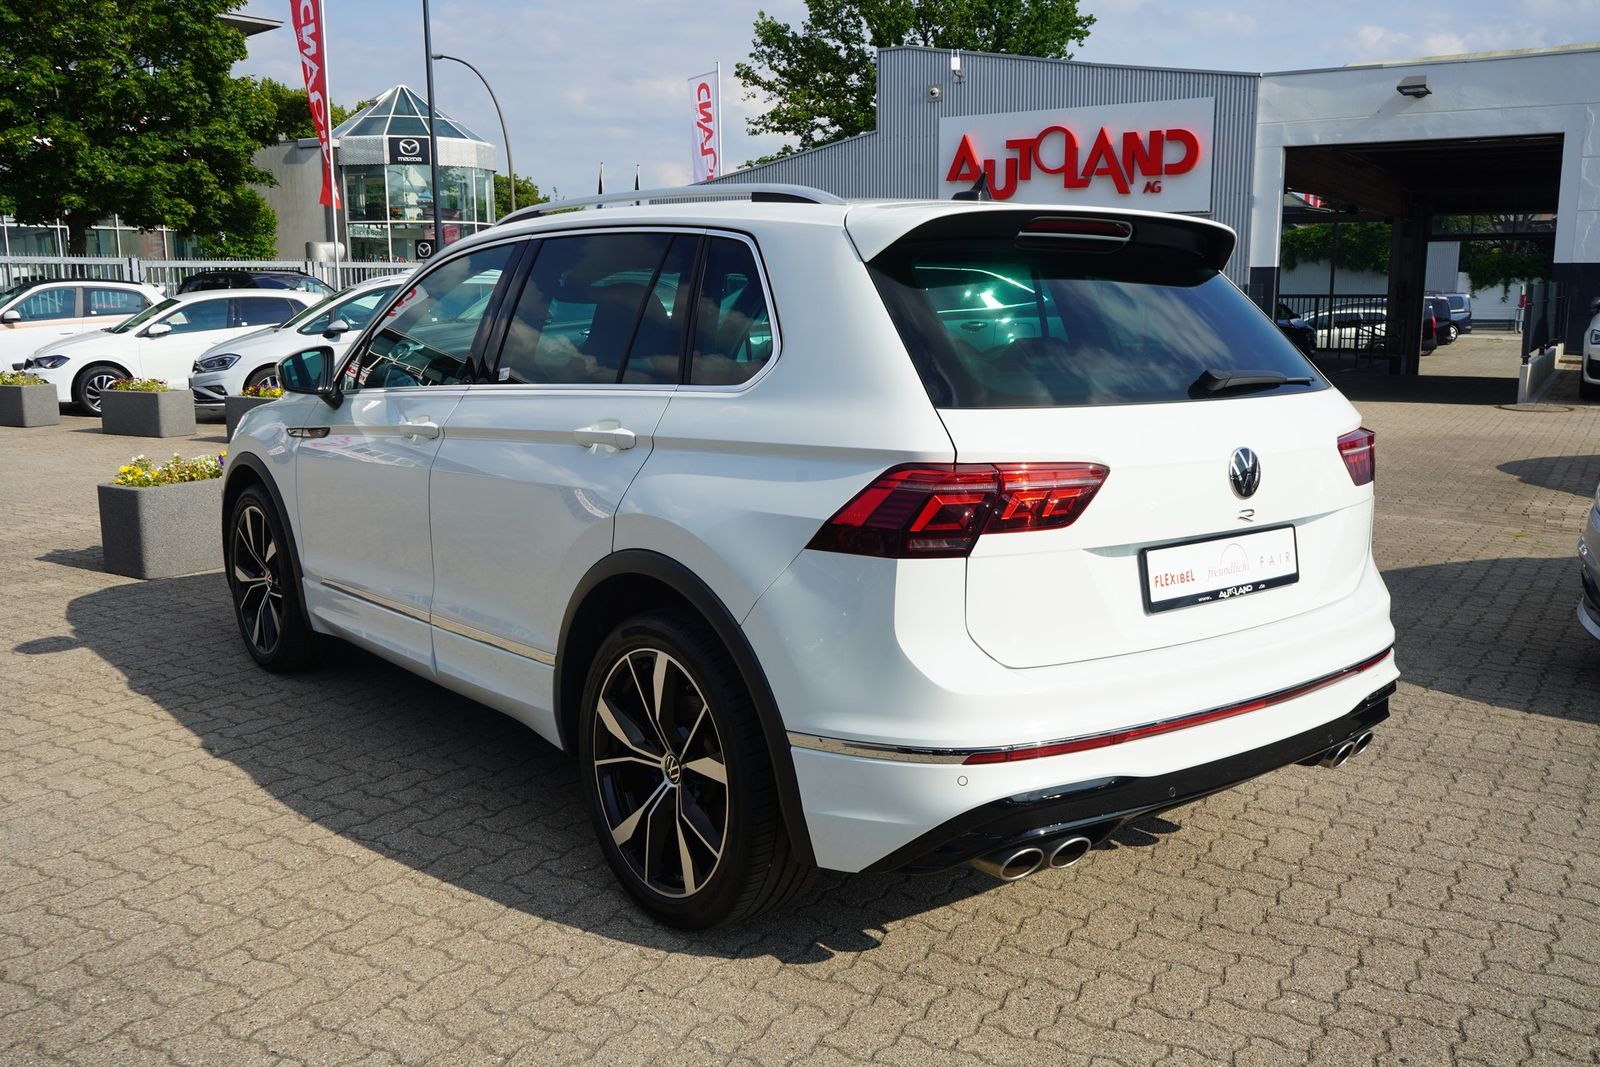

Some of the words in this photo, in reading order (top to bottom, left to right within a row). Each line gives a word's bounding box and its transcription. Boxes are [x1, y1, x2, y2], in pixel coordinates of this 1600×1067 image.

[946, 125, 1199, 200] AUTOLAND
[1143, 180, 1162, 194] AG
[1154, 569, 1196, 588] FLEXIBEL
[1218, 584, 1253, 599] AUTOLAND
